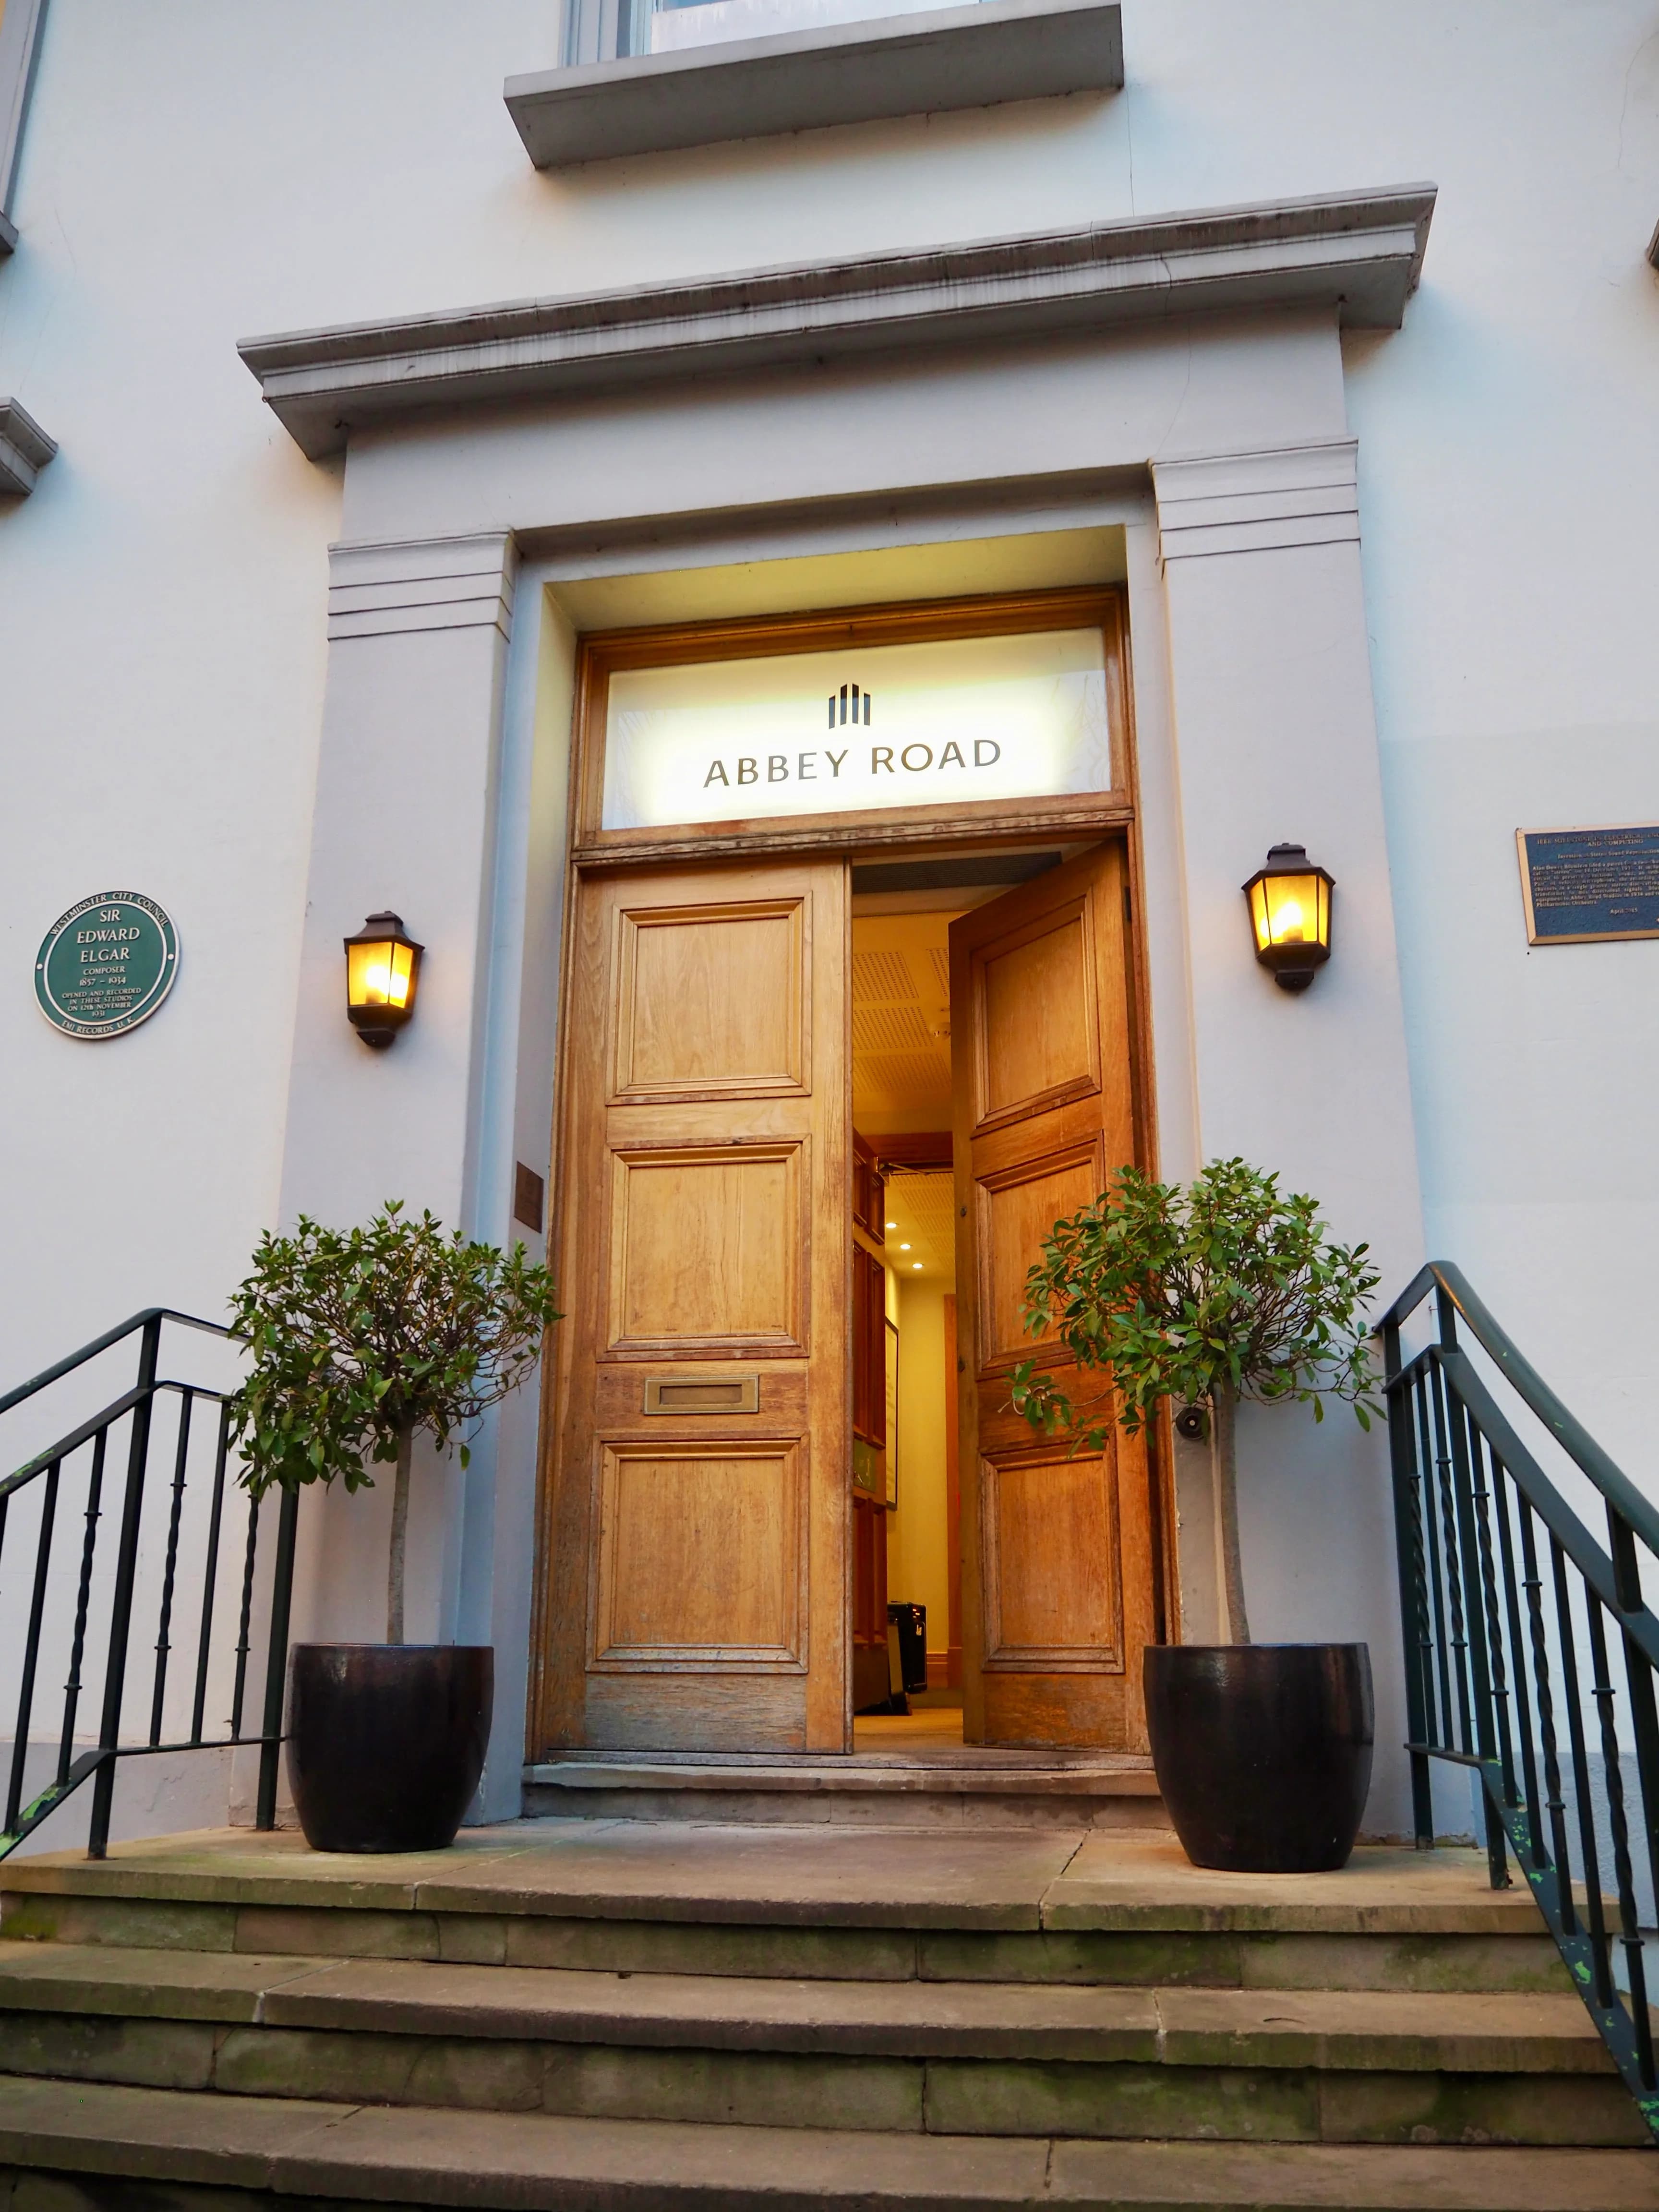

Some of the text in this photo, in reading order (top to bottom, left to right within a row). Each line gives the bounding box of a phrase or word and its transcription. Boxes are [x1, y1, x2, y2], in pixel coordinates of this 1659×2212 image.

[703, 739, 1001, 788] ABBEY ROAD
[50, 892, 169, 936] WESTMINSTER CITY COUNCIL
[100, 909, 121, 923] SIR
[77, 927, 140, 944] EDWARD
[80, 947, 131, 963] ELGAR
[83, 965, 125, 975] COMPOSER
[79, 978, 96, 986] 1857
[108, 976, 126, 986] 1934
[96, 1001, 132, 1010] NOVEMBER
[92, 1010, 105, 1018] 1931
[62, 1020, 75, 1031] EMI
[76, 1024, 114, 1034] RECORDS
